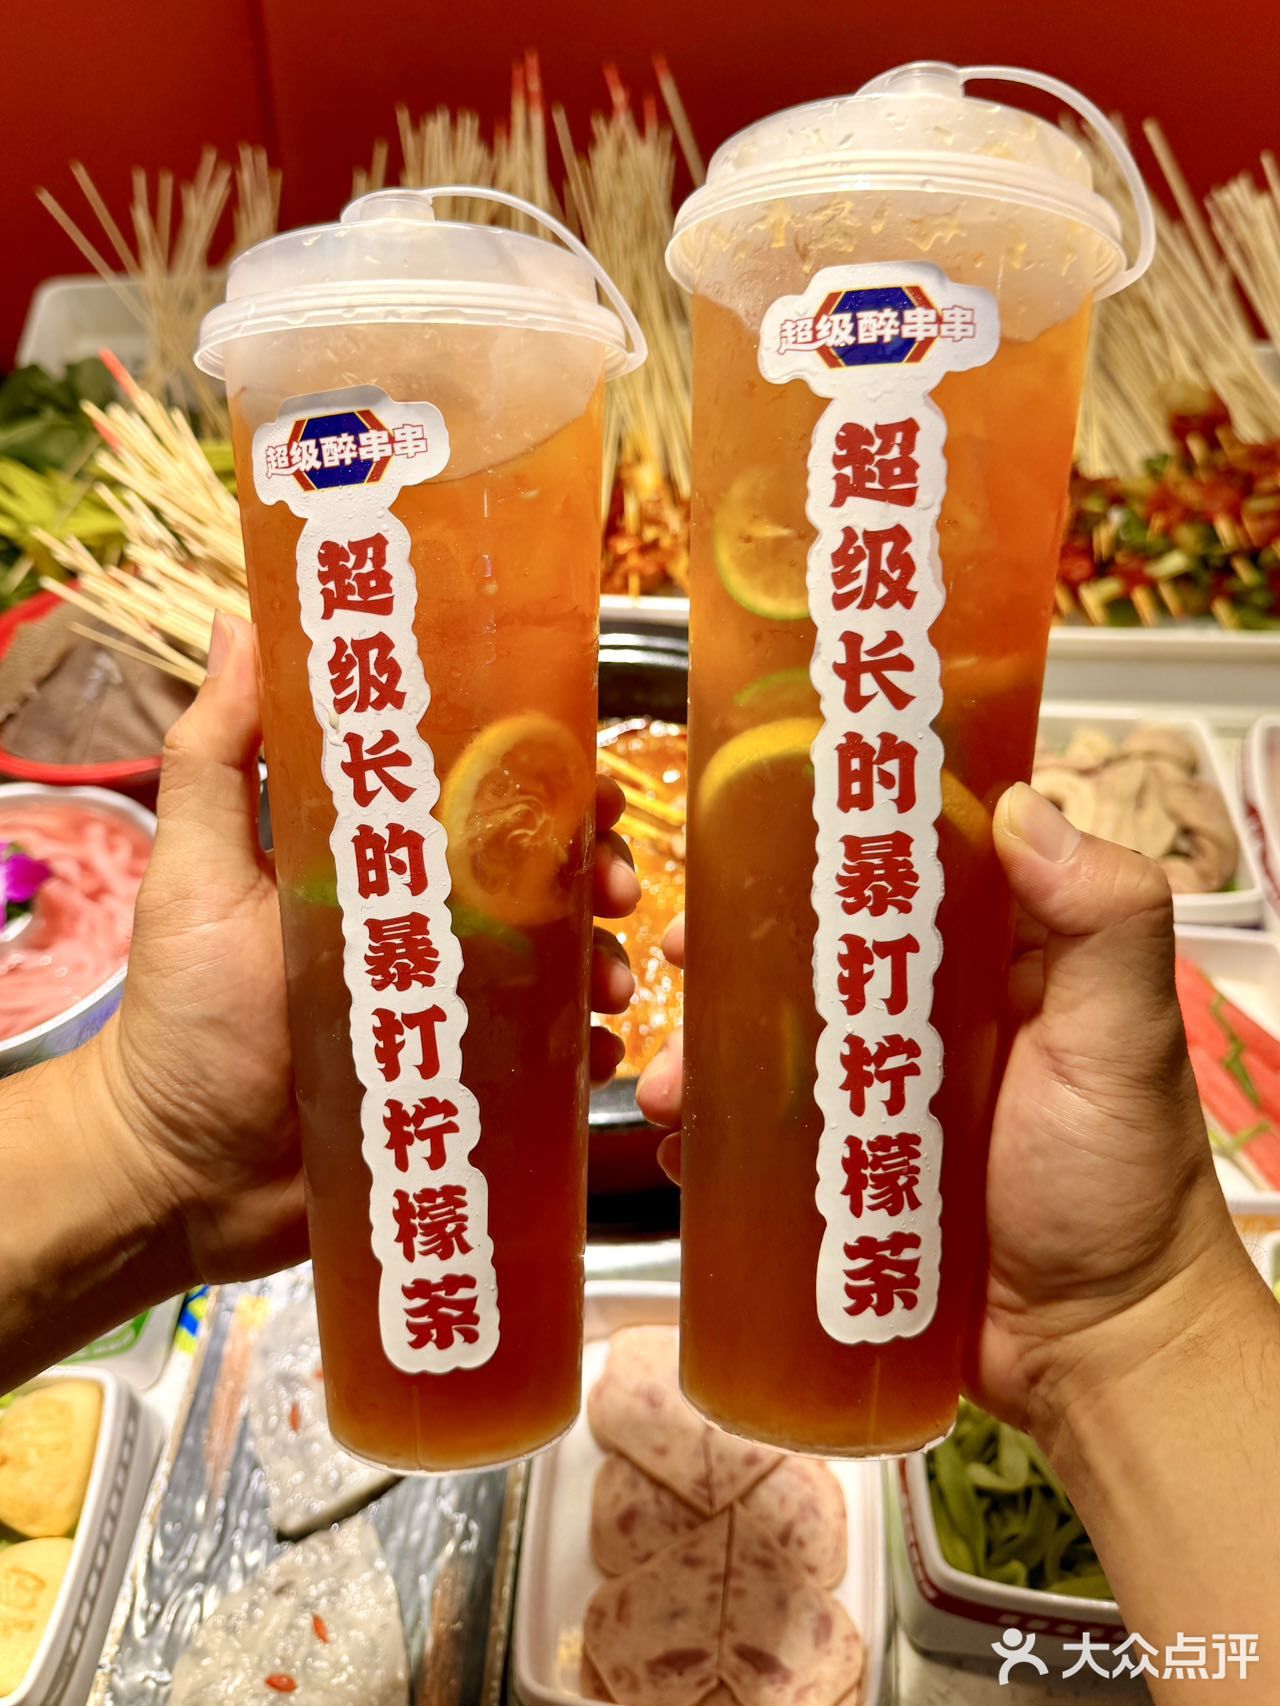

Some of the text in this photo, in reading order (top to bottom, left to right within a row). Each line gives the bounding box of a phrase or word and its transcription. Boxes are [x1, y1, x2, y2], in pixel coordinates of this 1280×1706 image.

[265, 424, 428, 479] 超级醉串串
[777, 305, 976, 355] 超级醉串串
[316, 532, 481, 1352] 超级长的暴打柠檬茶
[829, 416, 924, 1318] 超级长的暴打柠檬茶
